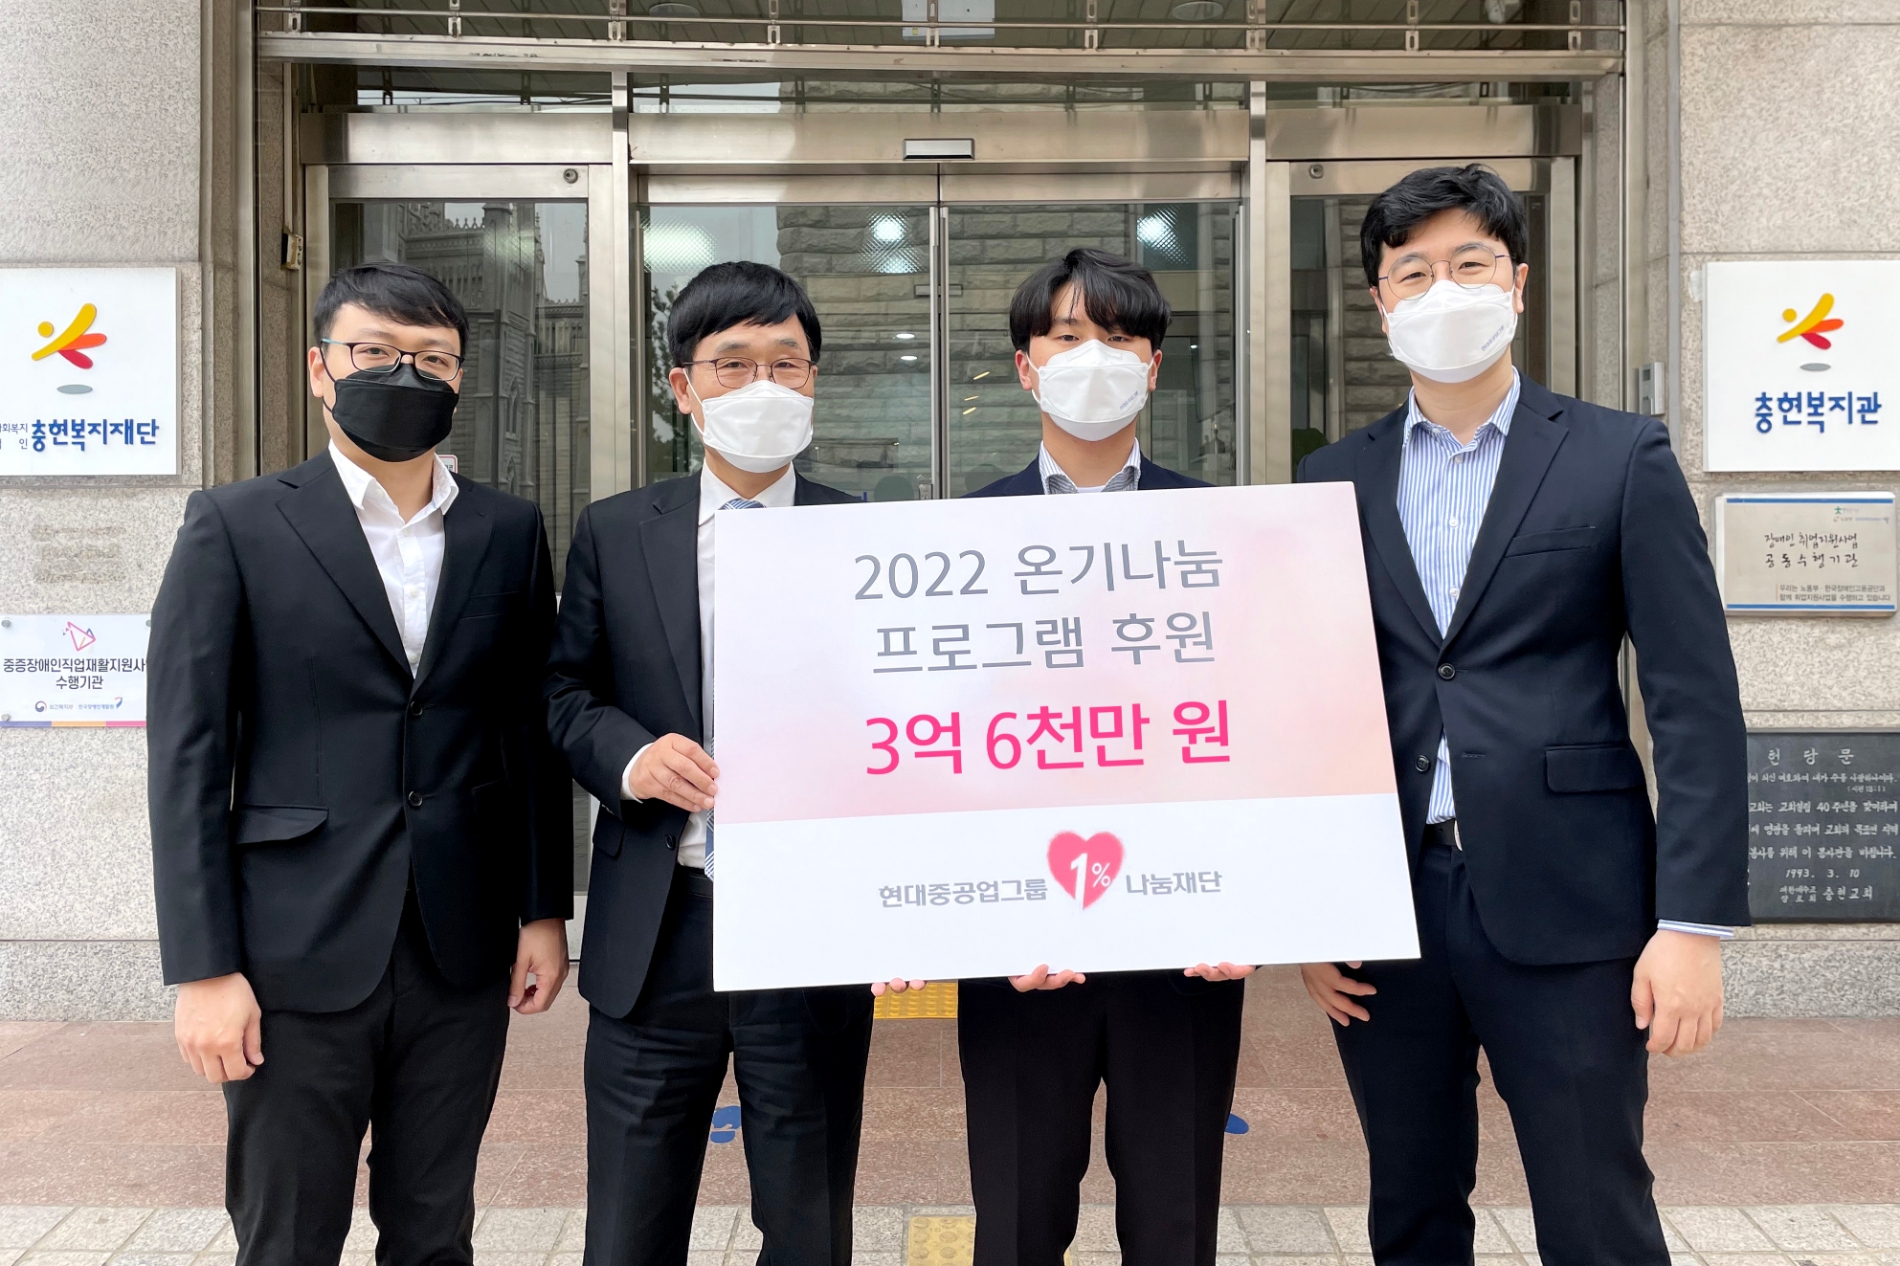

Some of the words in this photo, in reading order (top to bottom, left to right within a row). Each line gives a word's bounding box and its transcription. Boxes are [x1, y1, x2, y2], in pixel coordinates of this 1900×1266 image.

[1755, 391, 1882, 434] 충현복지관
[31, 418, 160, 452] 충현복지재단
[1764, 532, 1796, 549] 장애인
[1798, 531, 1858, 550] 취업지원사업
[854, 549, 989, 601] 2022
[1013, 539, 1223, 596] 온기나눔
[872, 616, 1085, 674] 프로그램
[1110, 611, 1216, 666] 후원
[3, 658, 146, 673] 중증장애인직업재활지원사
[56, 675, 104, 690] 수행기관
[865, 711, 963, 776] 3억
[986, 702, 1151, 771] 6천만
[1172, 699, 1231, 764] 원
[878, 877, 1048, 909] 현대중공업그룹
[1125, 869, 1223, 897] 나눔재단
